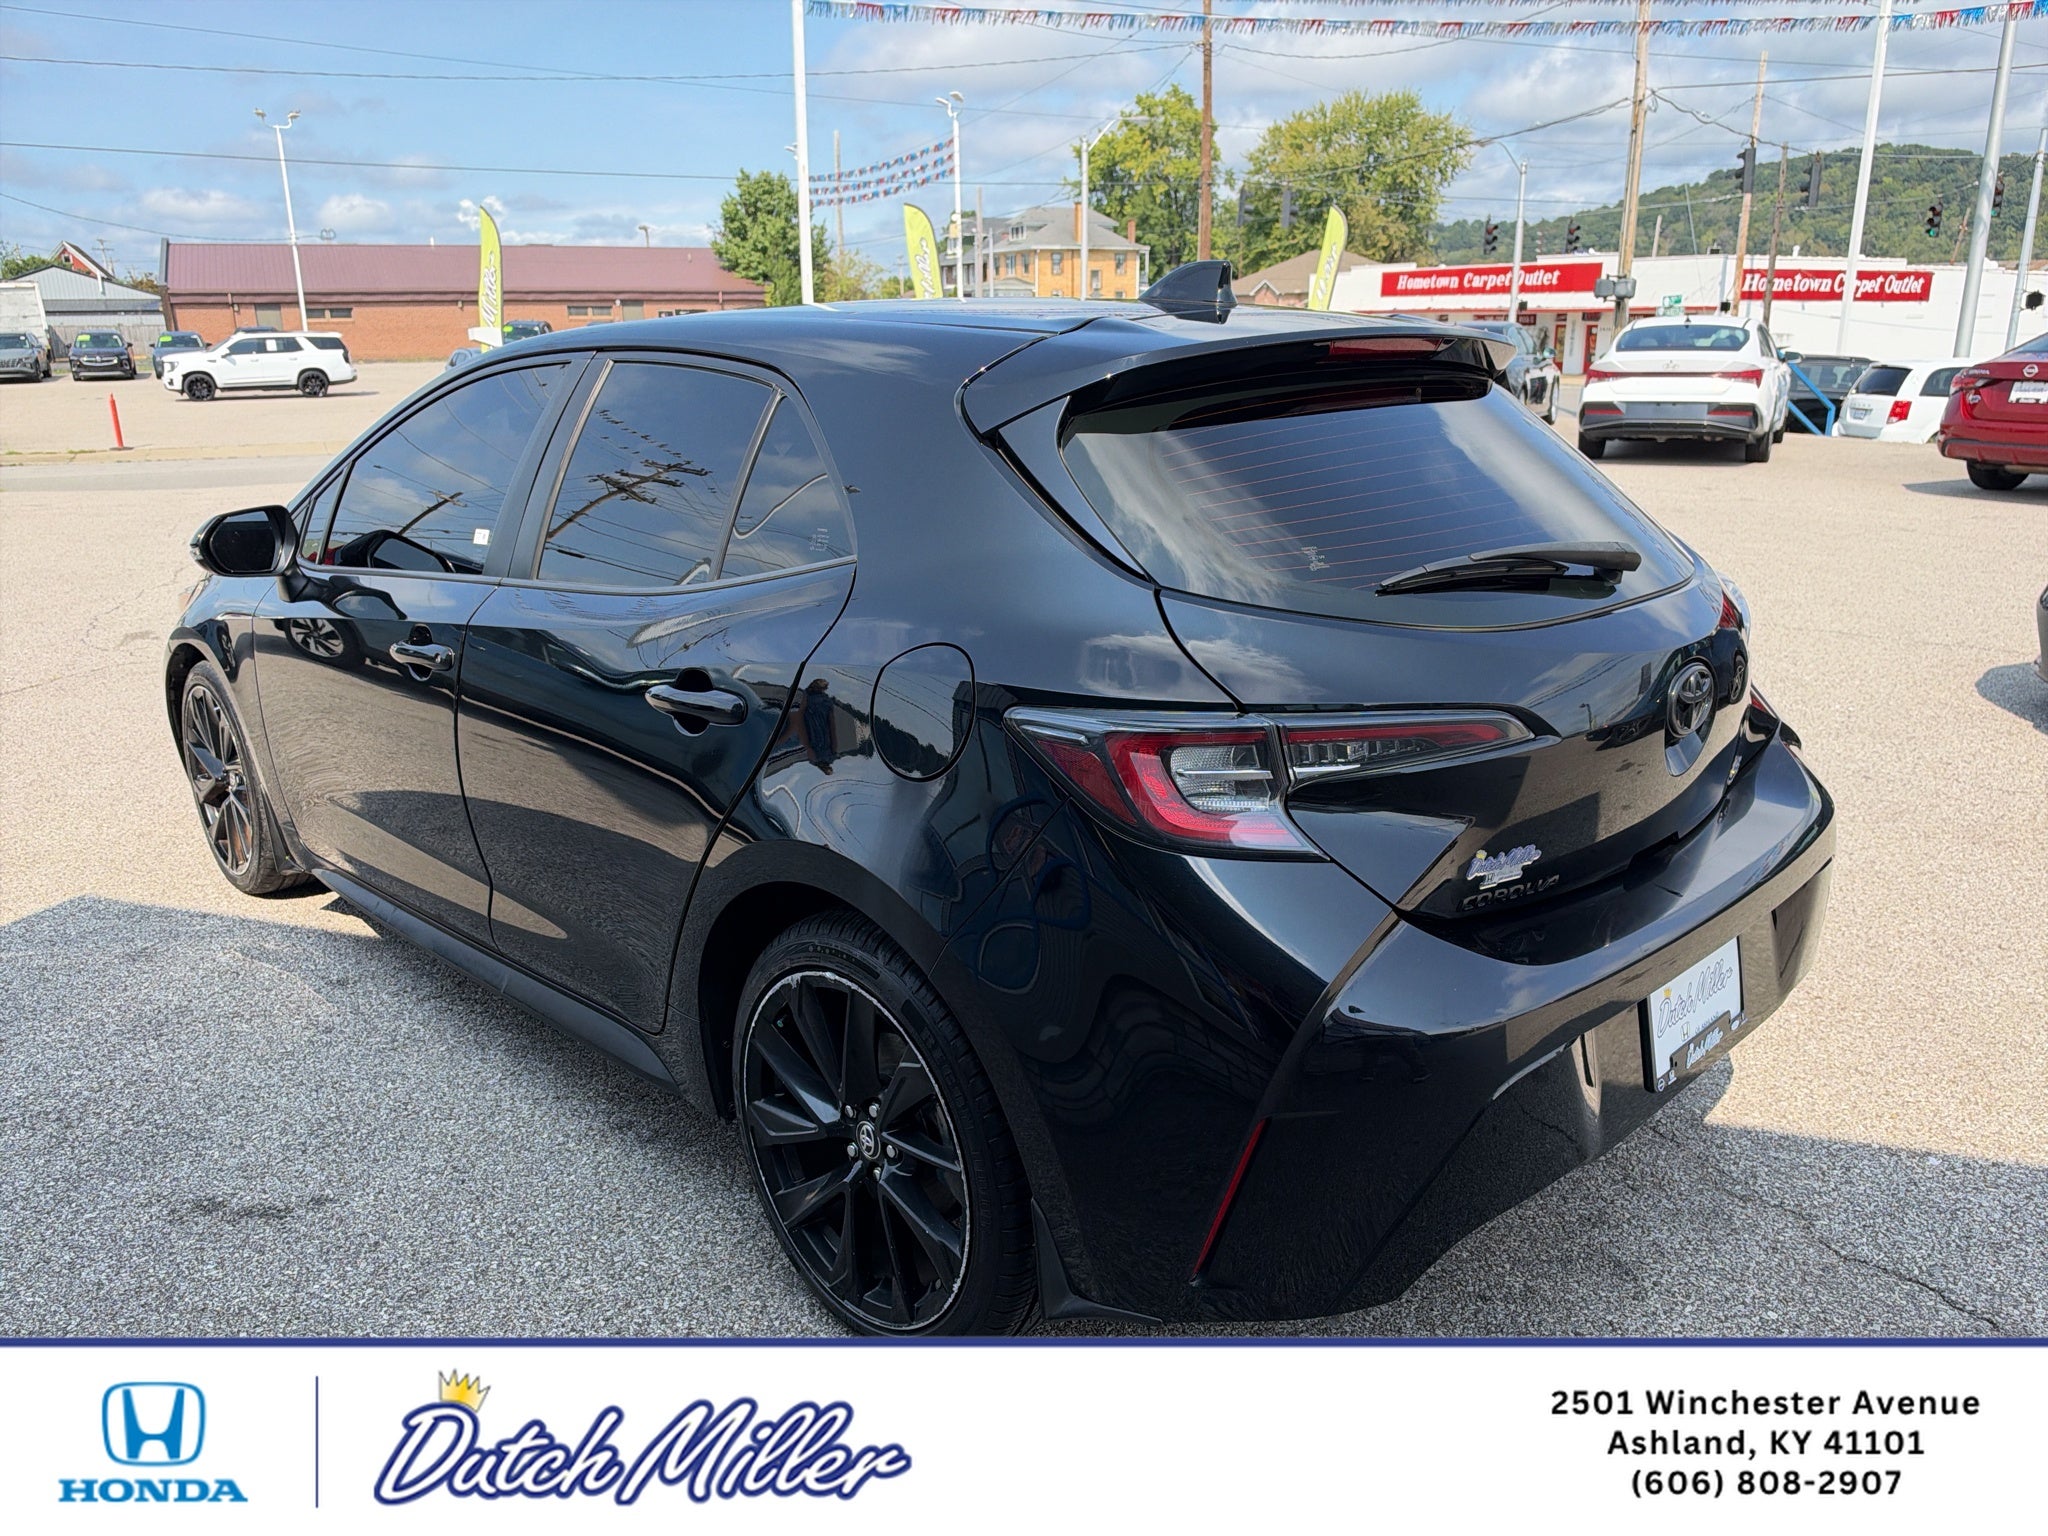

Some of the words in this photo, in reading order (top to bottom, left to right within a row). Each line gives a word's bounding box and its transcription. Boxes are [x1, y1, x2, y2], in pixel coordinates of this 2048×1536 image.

[1397, 274, 1459, 290] Hometown
[1463, 271, 1512, 290] Carpet
[1517, 268, 1561, 287] Outlet
[1742, 273, 1831, 293] Hometown
[1834, 274, 1884, 298] Crpet
[1885, 274, 1925, 294] Outlet
[1657, 981, 1697, 1038] Dutch
[1692, 957, 1734, 1014] Miller
